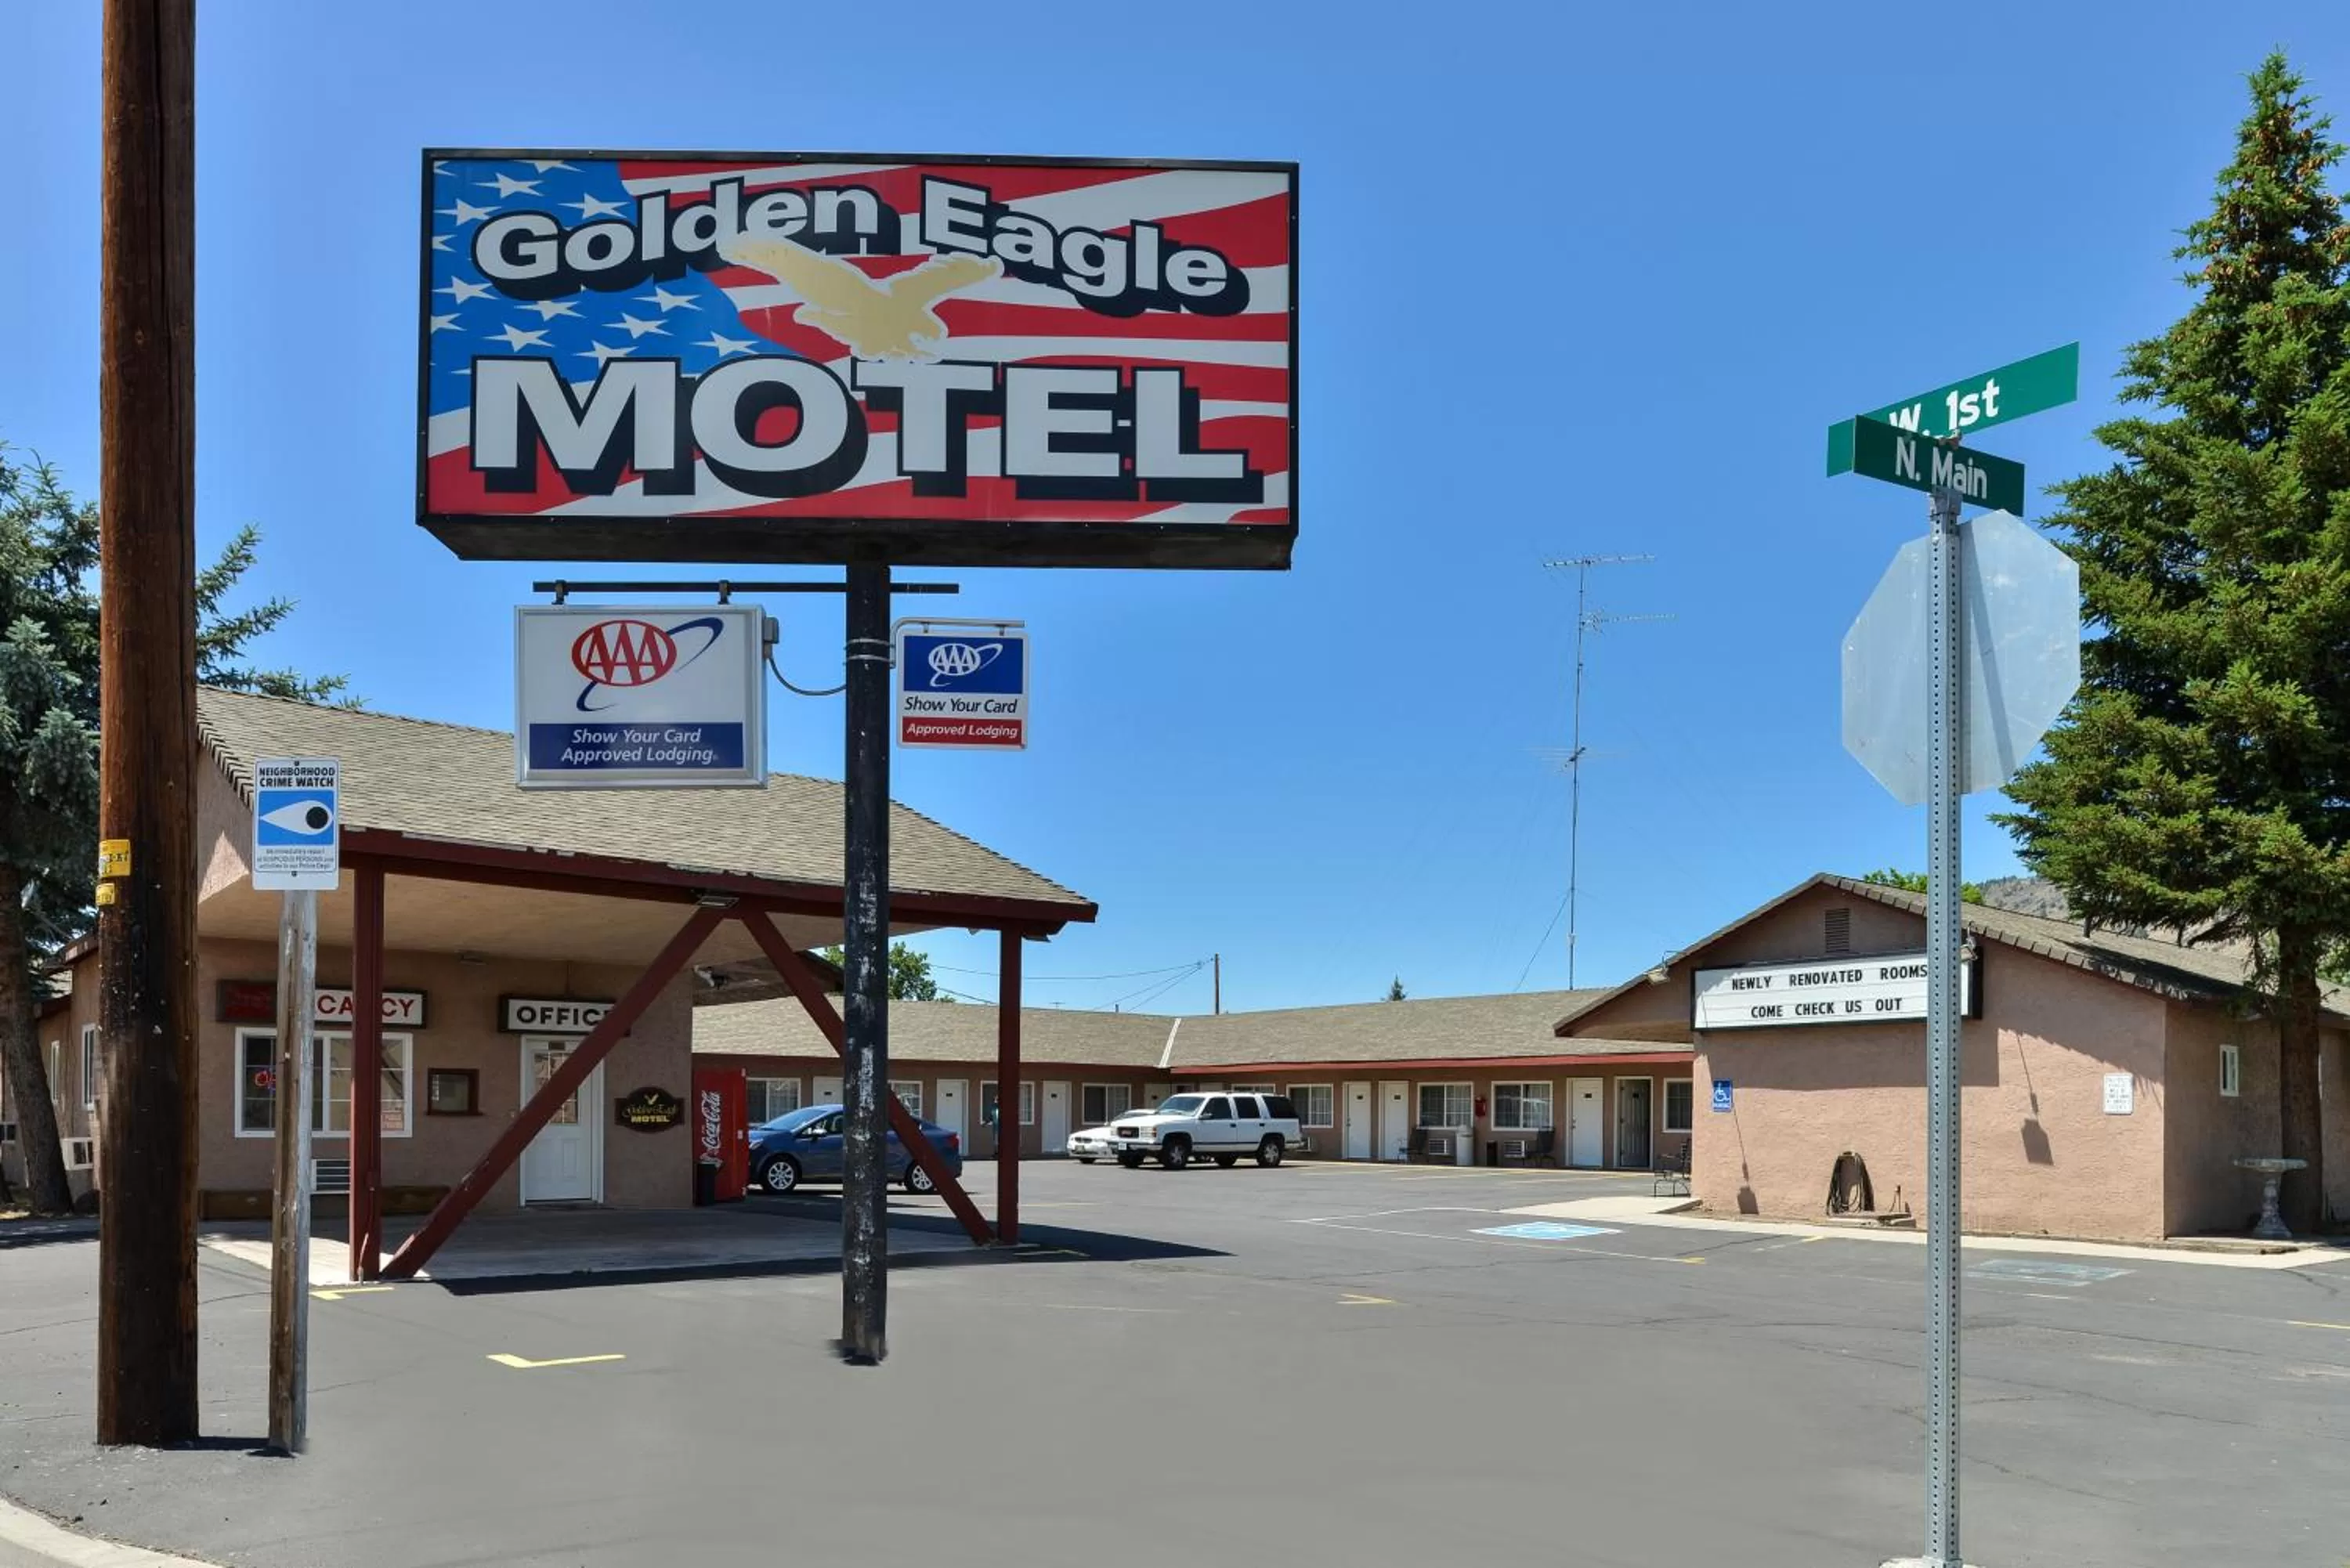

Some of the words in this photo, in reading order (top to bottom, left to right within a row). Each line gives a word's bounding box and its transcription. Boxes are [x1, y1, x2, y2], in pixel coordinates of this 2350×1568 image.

[473, 175, 884, 284] Golden
[922, 175, 1233, 302] Eagle
[1945, 378, 2000, 431] 1st
[472, 355, 1249, 484] MOTEL
[1895, 436, 1922, 481] N.
[1931, 446, 1987, 500] Main
[584, 620, 667, 685] AAA
[904, 695, 946, 710] Show
[950, 698, 981, 713] Your
[984, 699, 1018, 714] Card
[573, 729, 618, 743] Show
[623, 729, 660, 743] Your
[663, 728, 701, 743] Card
[906, 723, 967, 735] Approved
[968, 724, 1018, 739] Lodging
[561, 747, 643, 765] Approved
[646, 746, 714, 765] Lodging
[259, 767, 336, 776] NEIGHBORHOOD
[259, 777, 293, 787] CRIME
[295, 777, 334, 787] WATCH
[1732, 976, 1772, 991] NEWLY
[1789, 970, 1863, 986] RENOVATED
[1880, 964, 1928, 979] ROOMS
[516, 1006, 613, 1027] OFFIC
[1751, 1005, 1784, 1018] COME
[1795, 1001, 1835, 1016] CHECK
[1845, 999, 1862, 1013] US
[1875, 998, 1903, 1012] OUT
